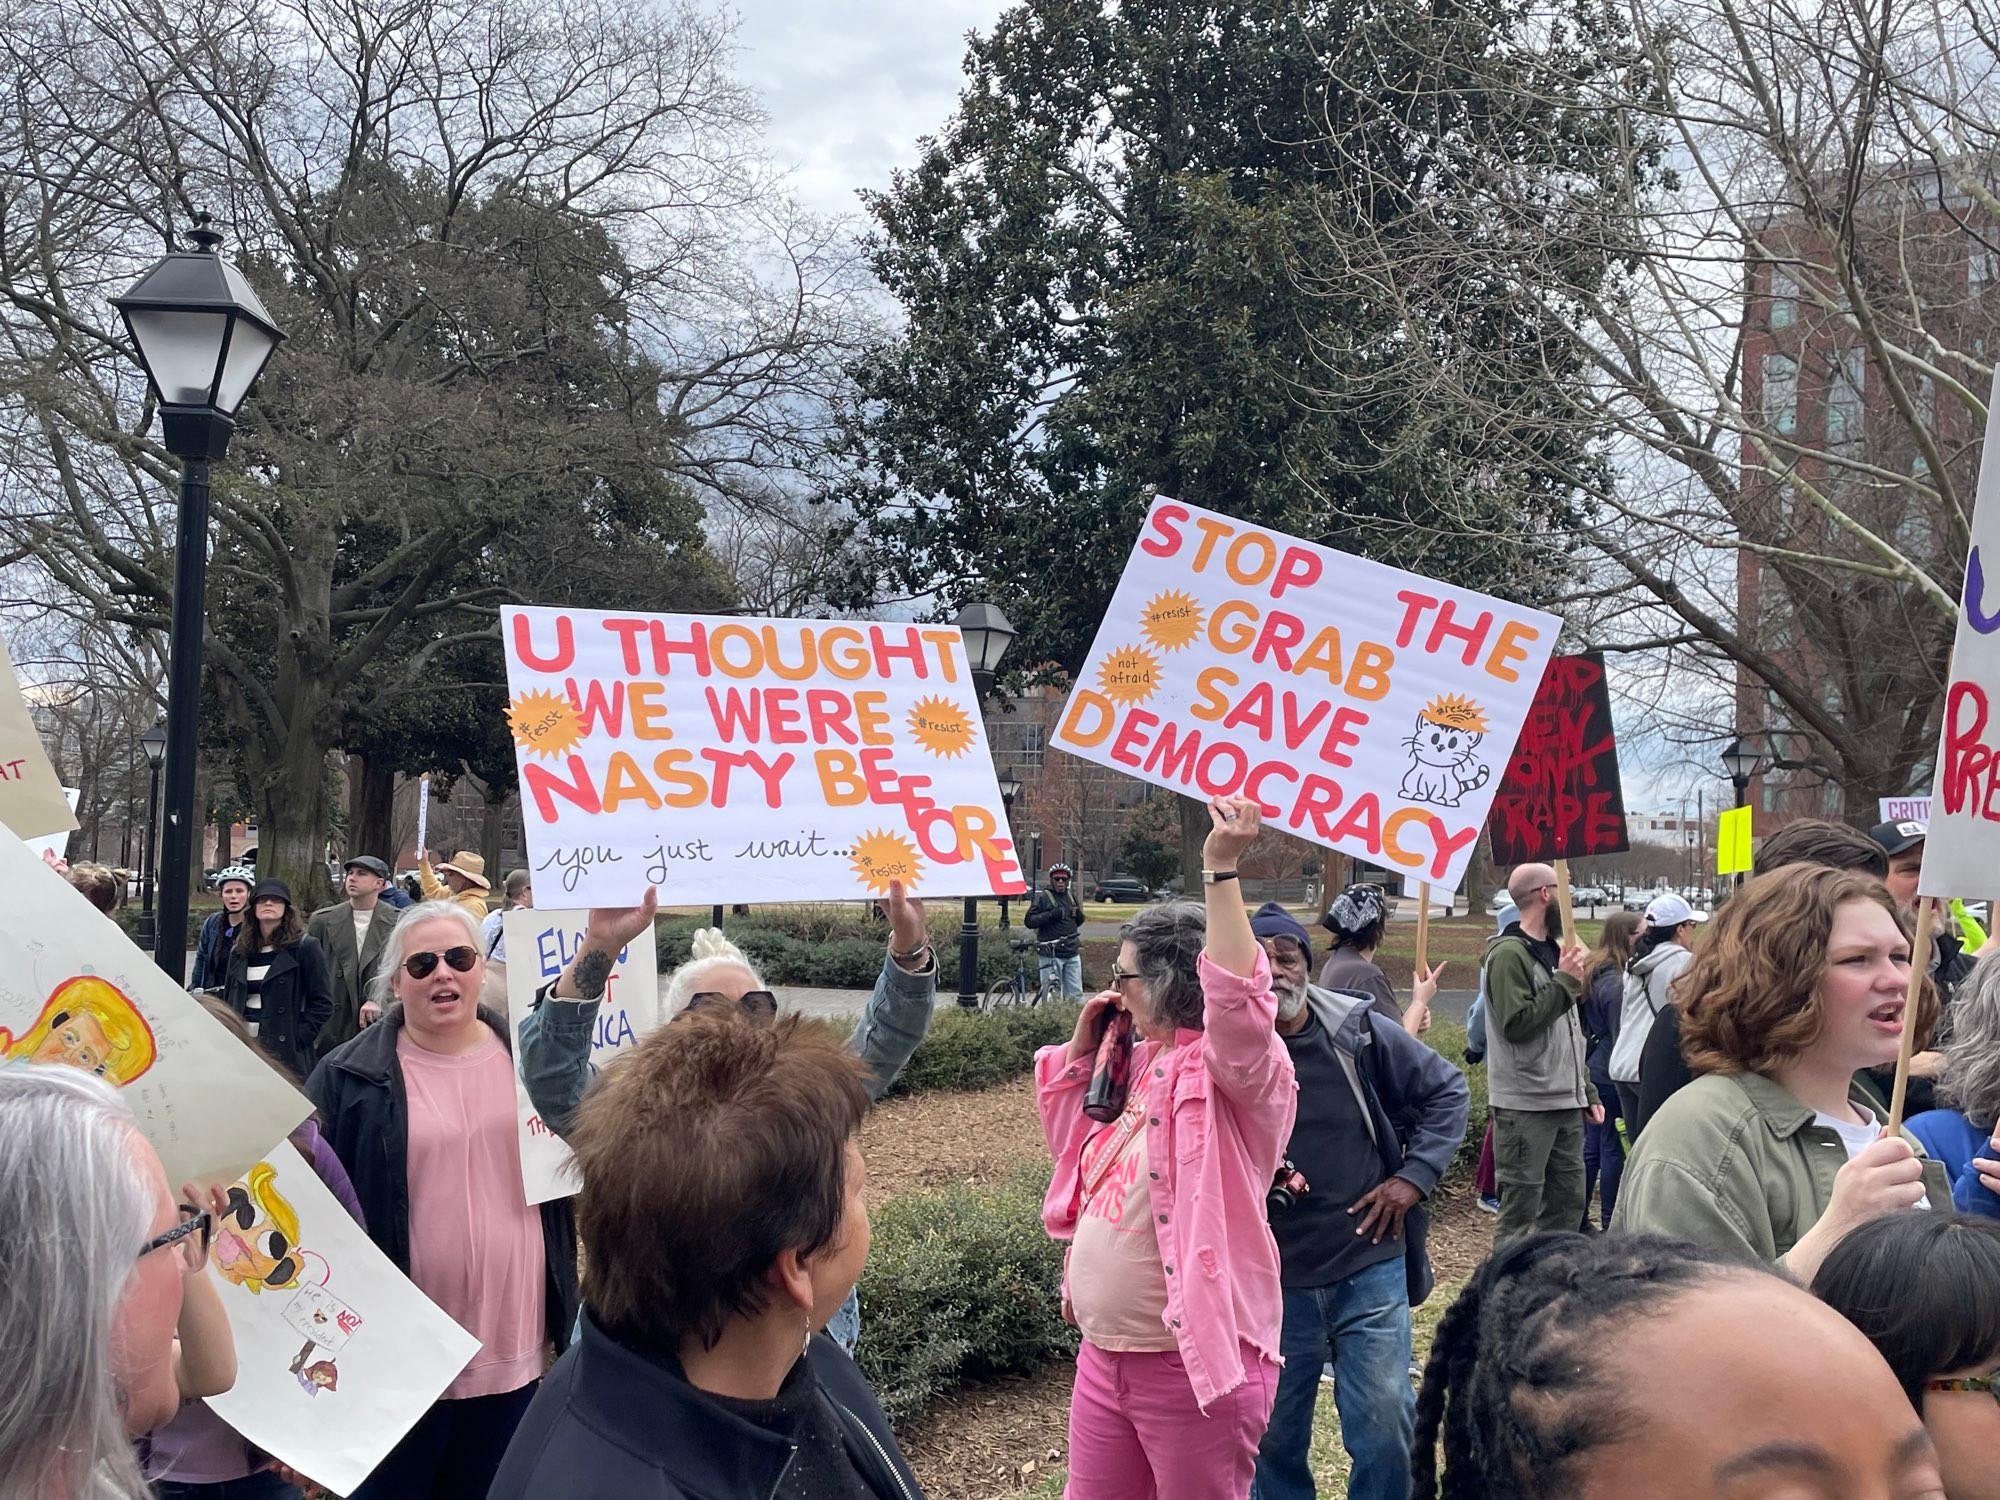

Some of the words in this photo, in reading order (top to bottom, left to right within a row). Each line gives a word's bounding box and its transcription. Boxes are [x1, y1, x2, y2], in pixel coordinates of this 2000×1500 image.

[1140, 505, 1323, 598] STOP
[1396, 590, 1539, 682] THE
[1151, 606, 1191, 622] #resist
[513, 614, 575, 673] U
[603, 618, 960, 683] THOUGHT
[1118, 658, 1138, 669] not
[1208, 600, 1395, 700] GRAB
[1110, 670, 1150, 683] afraid
[519, 710, 563, 742] #resist
[565, 678, 673, 739] WE
[705, 687, 893, 745] WERE
[919, 717, 963, 733] #resist
[1190, 667, 1369, 768] SAVE
[1060, 688, 1477, 879] DEMOCRACY
[523, 747, 794, 824] NASTY
[814, 748, 1027, 896] BEFORE
[1888, 801, 1931, 820] CRITI
[536, 845, 623, 892] you
[643, 834, 713, 884] just
[862, 856, 907, 878] #resist
[336, 1310, 363, 1329] NOT
